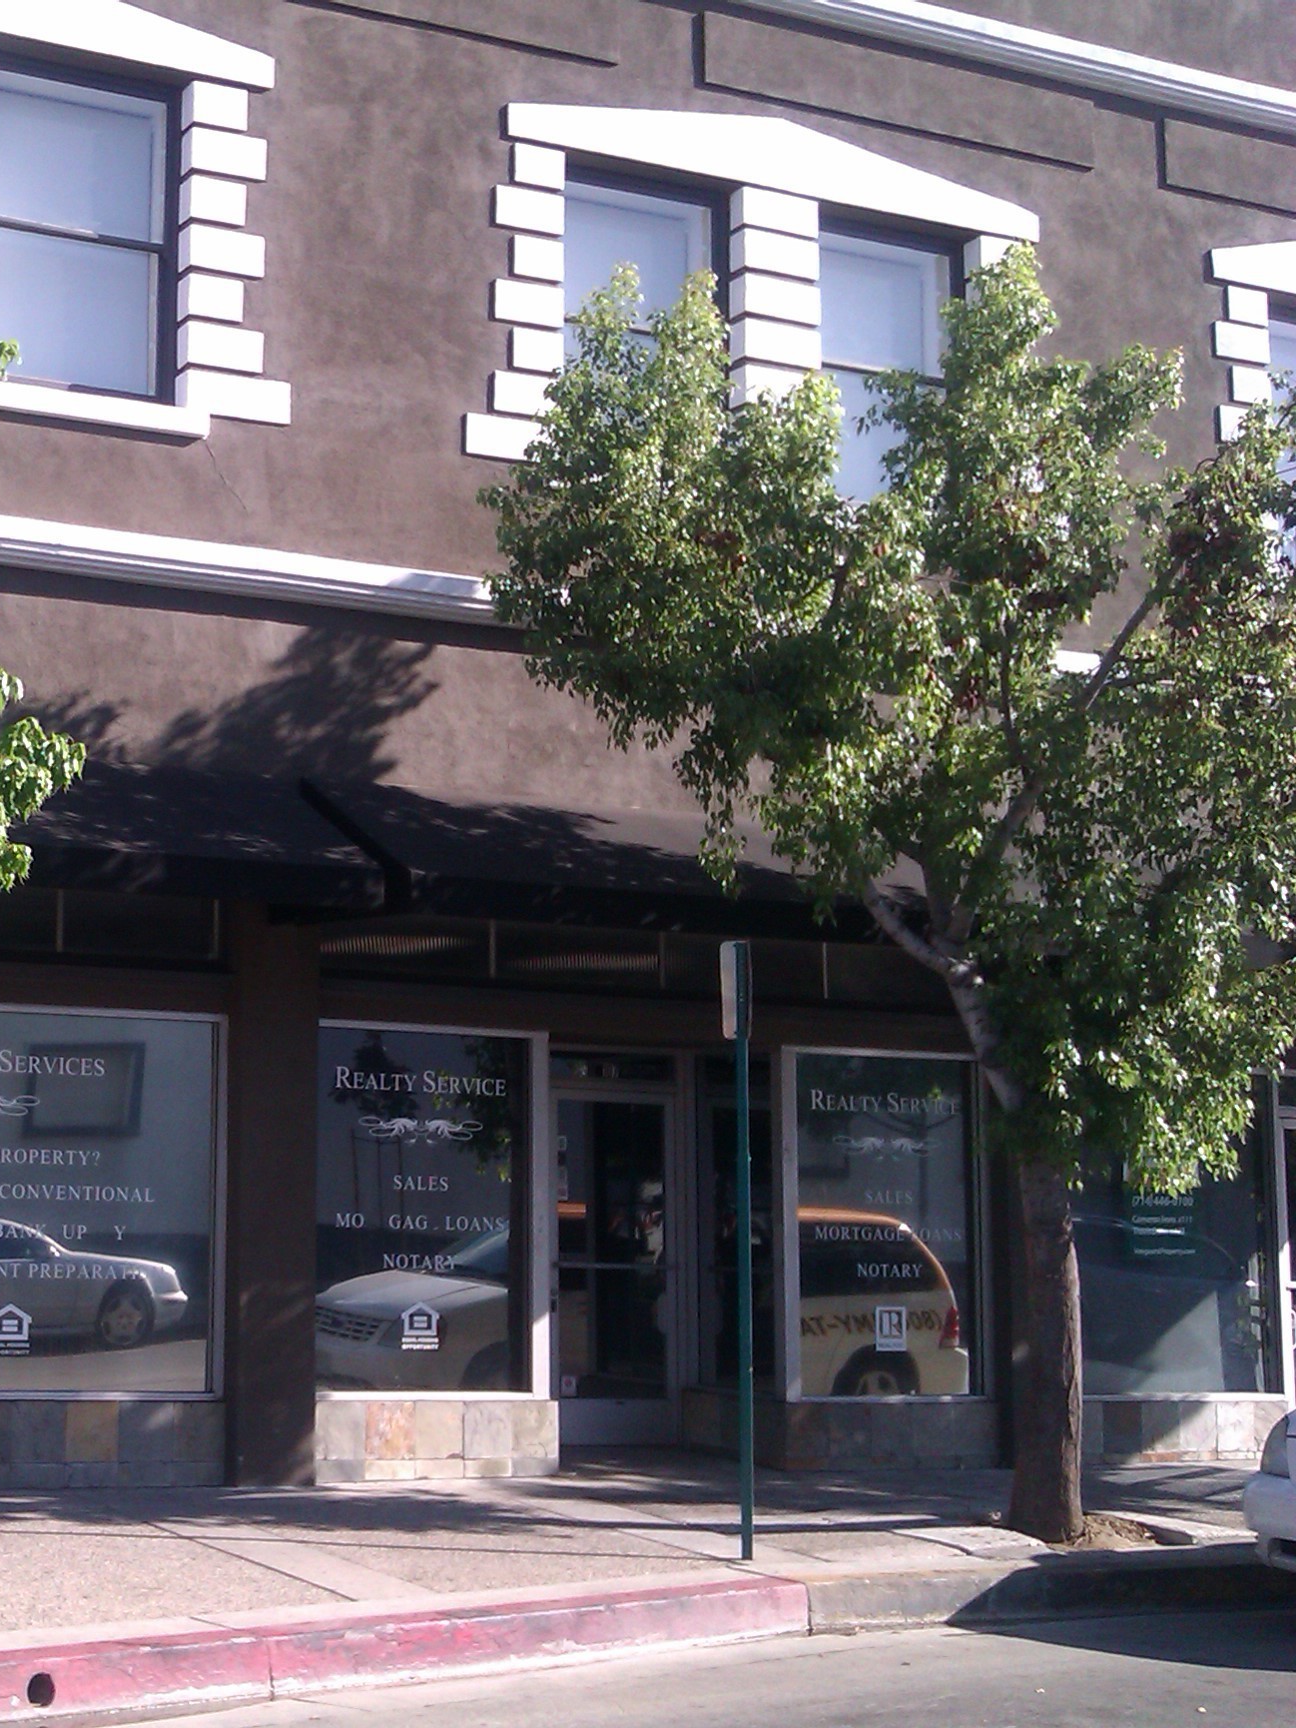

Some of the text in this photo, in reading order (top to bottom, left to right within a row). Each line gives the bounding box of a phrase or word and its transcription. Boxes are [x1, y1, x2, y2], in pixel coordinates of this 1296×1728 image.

[334, 1065, 507, 1097] REALTY SERVICE
[810, 1089, 961, 1116] REALTY SERVICE
[393, 1174, 449, 1192] SALES
[864, 1189, 914, 1205] SALES
[445, 1215, 505, 1233] LOANS
[815, 1226, 962, 1242] MORTGAGE OANS
[382, 1253, 458, 1270] NOTARY
[857, 1262, 922, 1279] NOTARY
